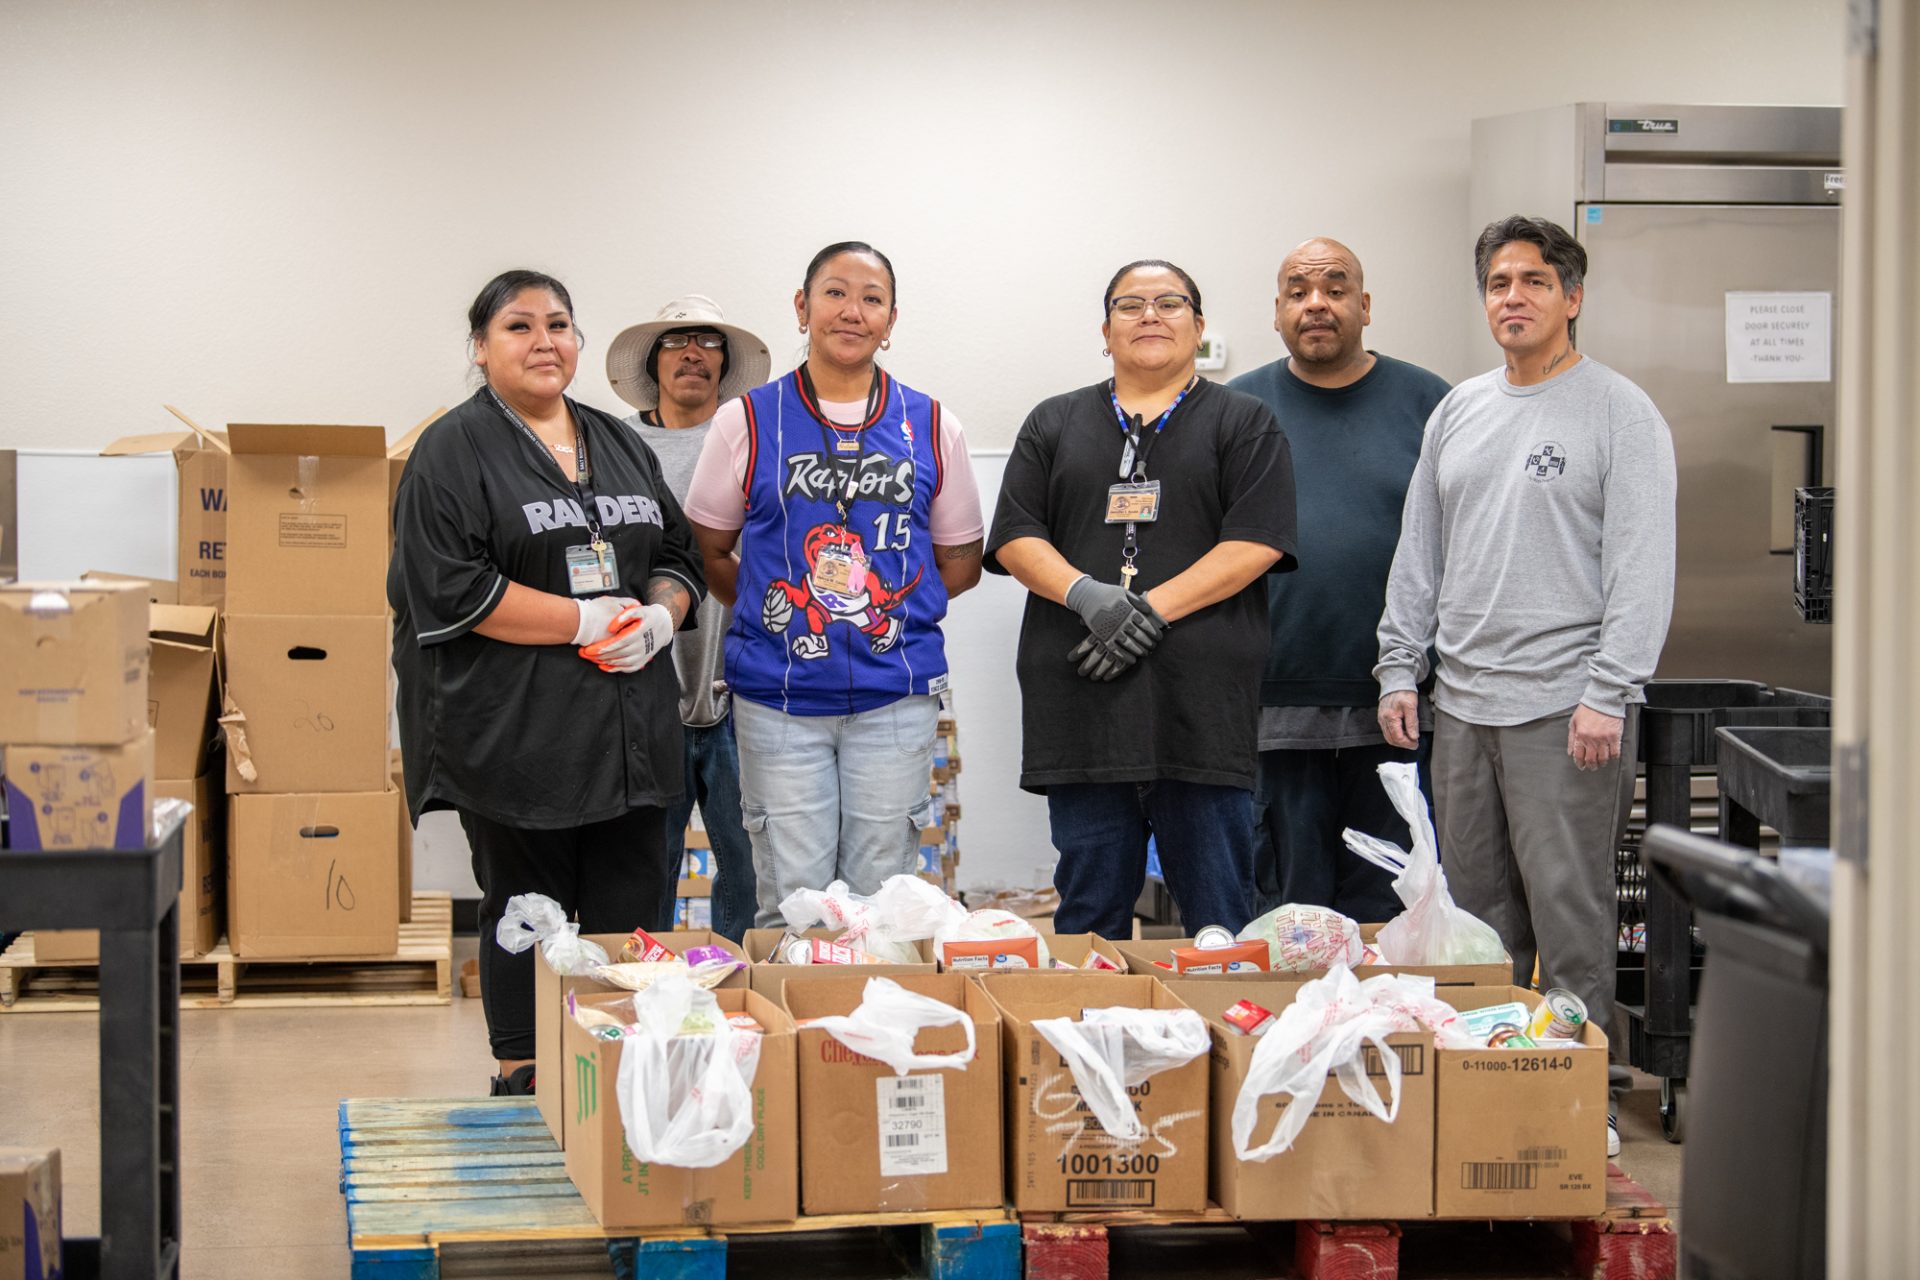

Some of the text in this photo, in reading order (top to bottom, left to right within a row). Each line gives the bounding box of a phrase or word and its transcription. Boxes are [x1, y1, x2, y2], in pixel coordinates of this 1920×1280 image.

[1825, 175, 1846, 184] Free
[1750, 305, 1805, 314] PLEASE CLOSE
[1744, 320, 1810, 331] DOOR SECURELY
[1750, 338, 1805, 347] AT ALL TIMES
[873, 512, 912, 551] 15
[199, 541, 227, 560] RE
[326, 858, 356, 911] 10
[1462, 1056, 1573, 1072] 0-11000-12614-0
[892, 1120, 923, 1130] 32790
[757, 1145, 765, 1170] COOL
[1057, 1153, 1160, 1174] 1001300
[622, 1175, 632, 1184] A
[743, 1175, 752, 1200] KEEP
